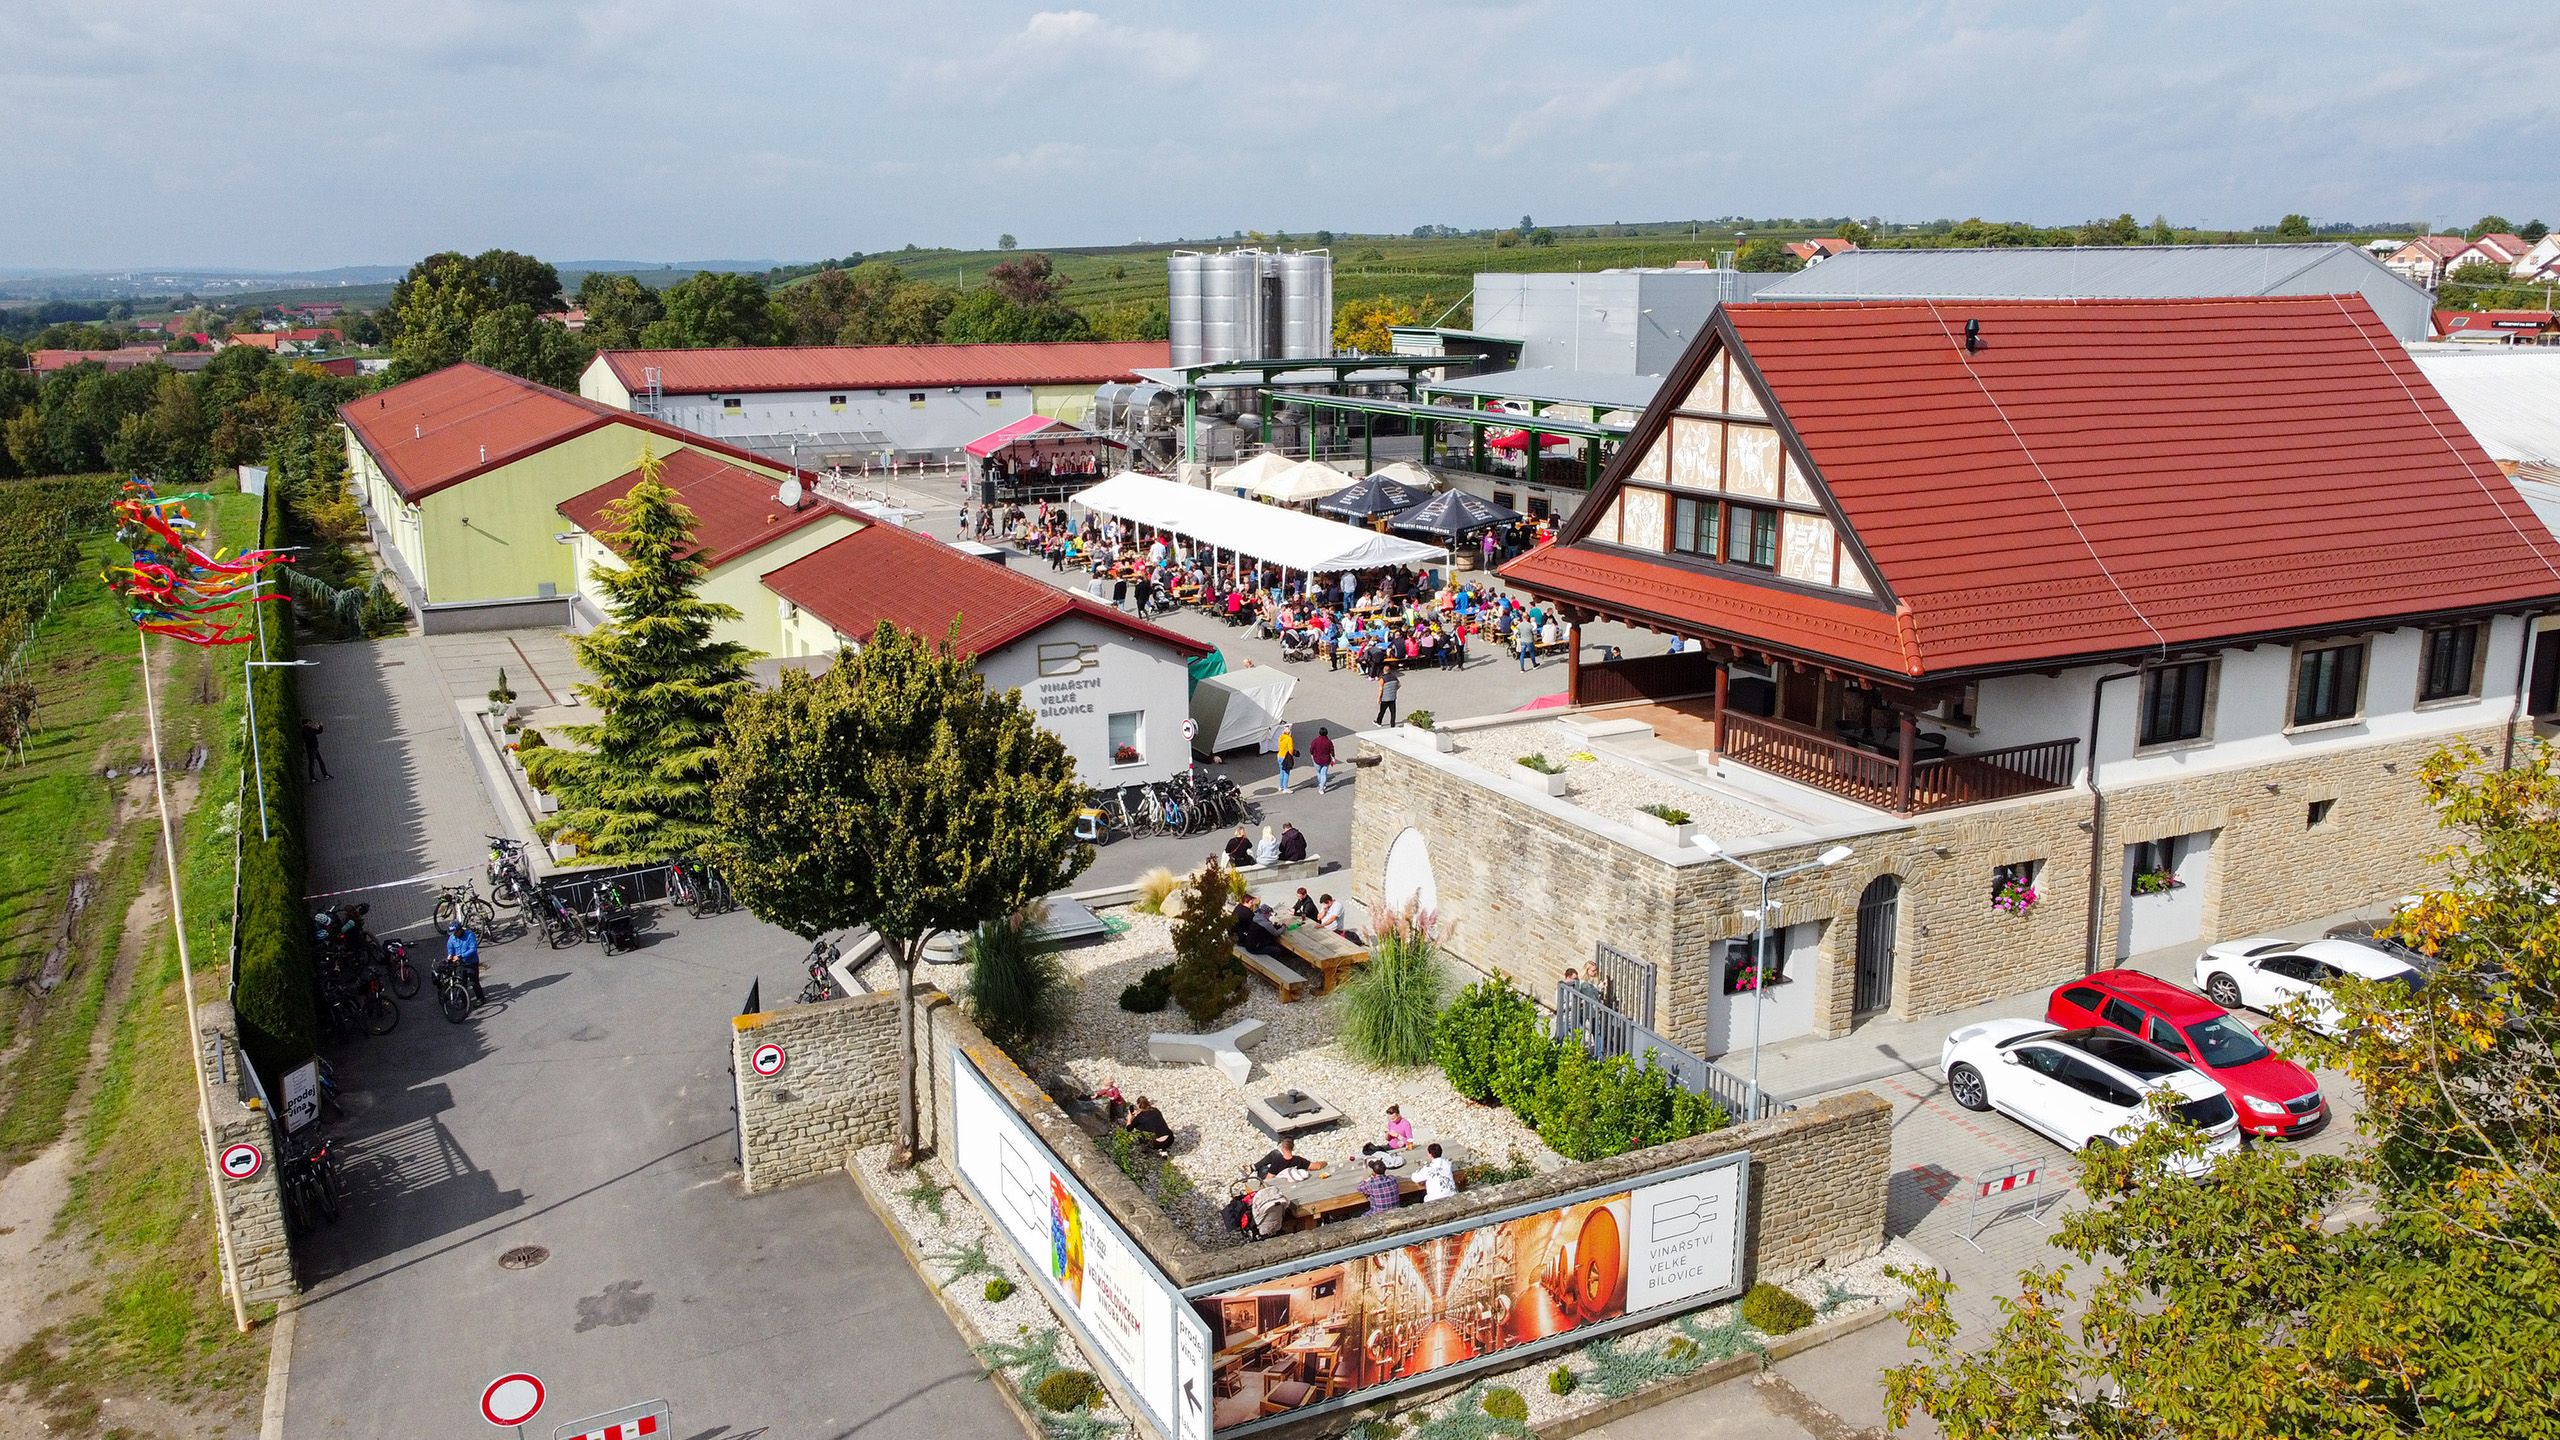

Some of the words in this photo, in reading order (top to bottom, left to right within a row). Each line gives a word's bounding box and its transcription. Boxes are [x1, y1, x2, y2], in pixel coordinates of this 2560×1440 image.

[1040, 677, 1101, 693] VINAŘSTVÍ
[1040, 692, 1077, 706] VELKÉ
[1041, 703, 1095, 718] BÍLOVICE
[287, 1084, 316, 1111] prodej
[1650, 1232, 1713, 1259] VINAŘSTVÍ
[1649, 1255, 1687, 1274] VELKÉ
[1648, 1265, 1704, 1289] BÍLOVICE
[1179, 1320, 1204, 1360] prodej
